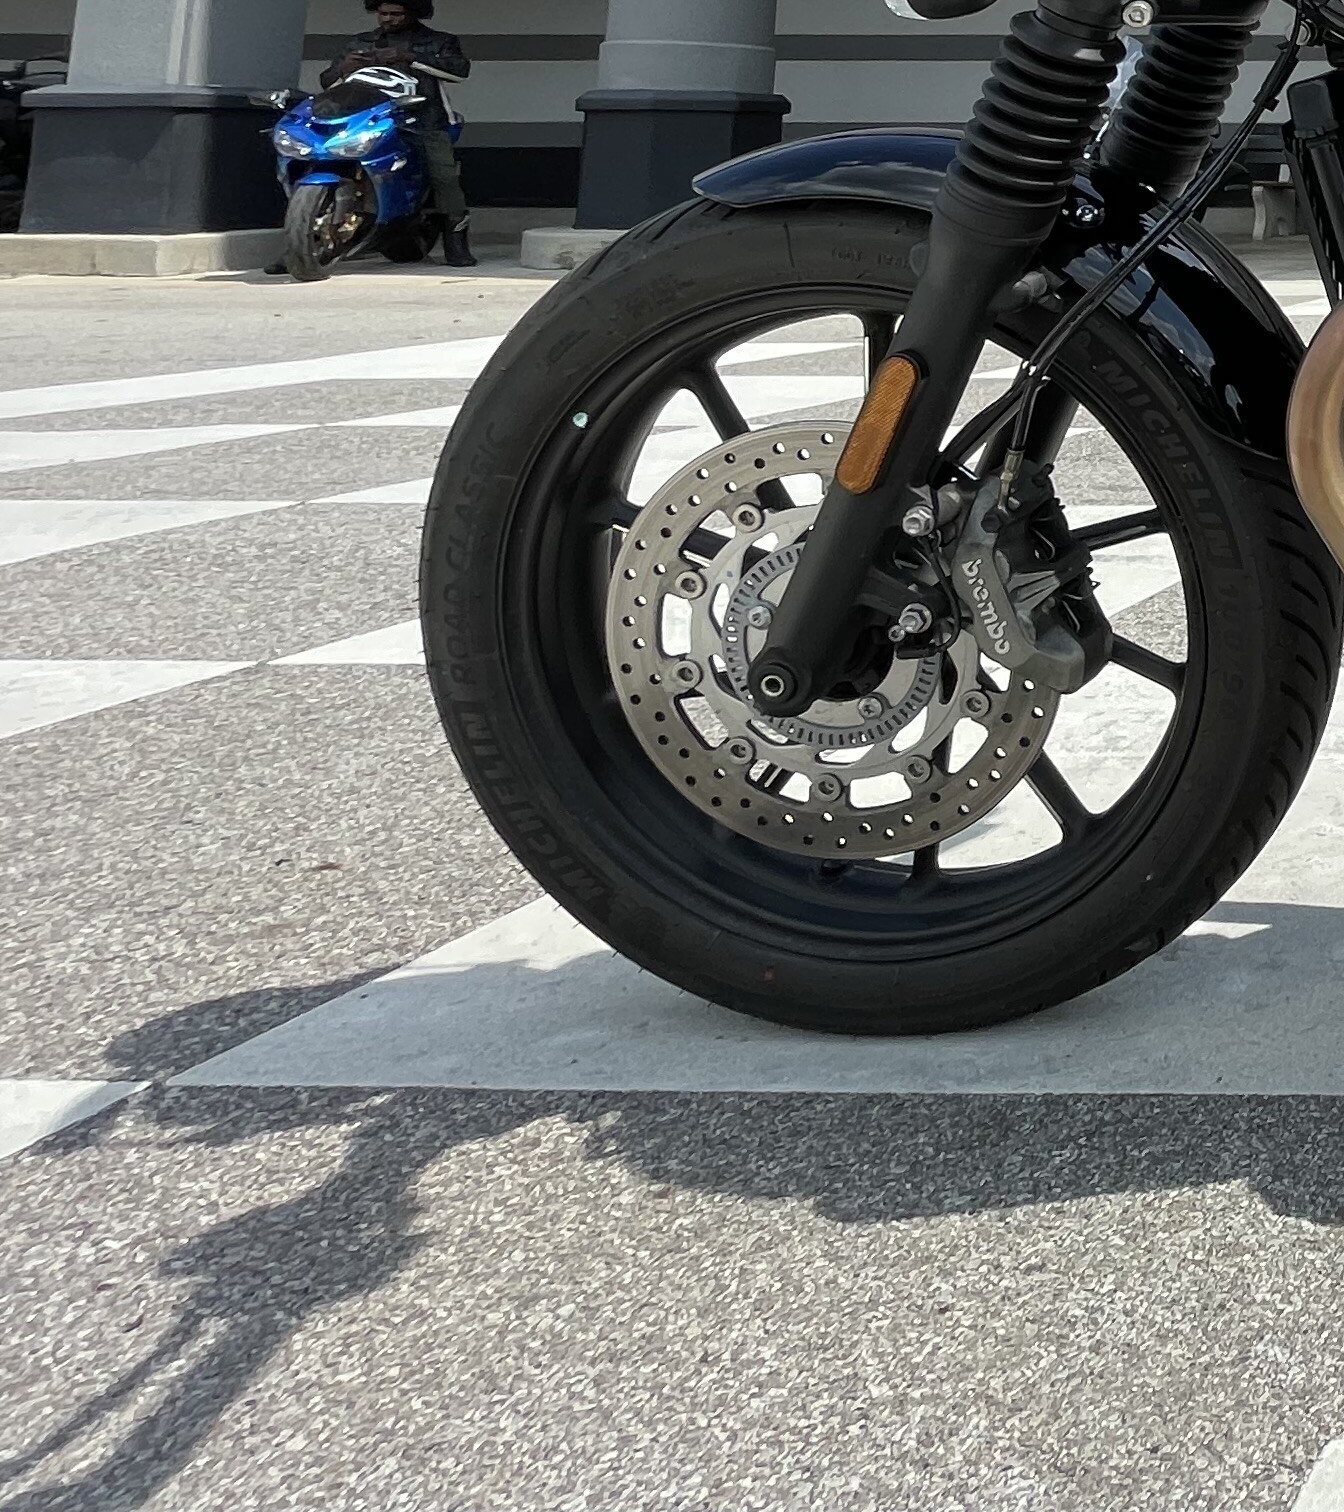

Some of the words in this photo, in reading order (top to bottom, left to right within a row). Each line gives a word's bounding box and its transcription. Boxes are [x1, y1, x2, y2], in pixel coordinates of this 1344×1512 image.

[449, 421, 501, 576] CLASSIC
[1095, 361, 1234, 558] MICHELIN
[445, 581, 478, 689] ROAD
[961, 556, 1011, 656] brembo
[459, 708, 605, 906] MICHELIN
